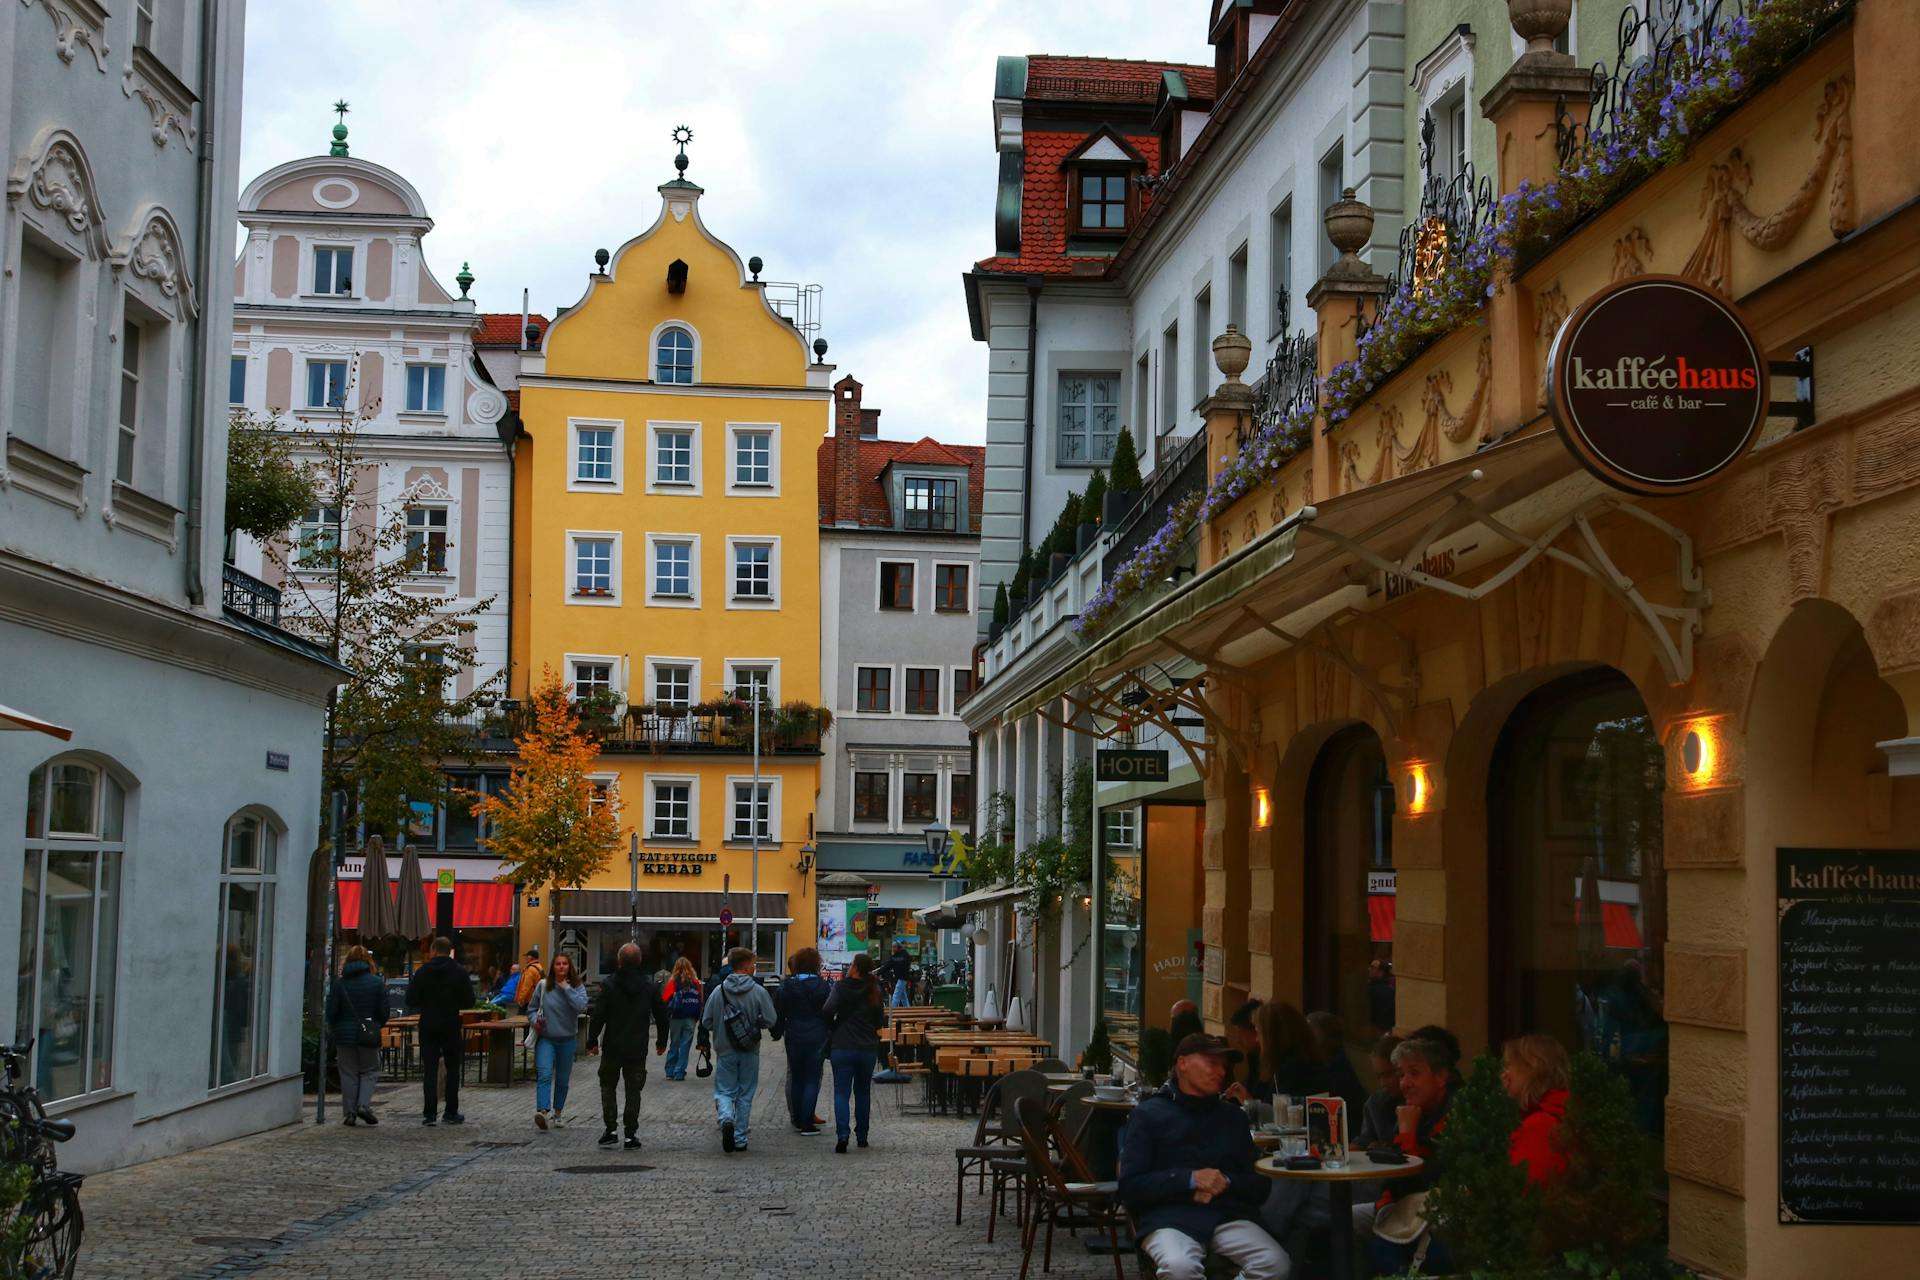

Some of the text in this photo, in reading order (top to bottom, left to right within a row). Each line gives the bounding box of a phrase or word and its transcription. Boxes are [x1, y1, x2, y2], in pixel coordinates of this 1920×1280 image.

[1572, 355, 1756, 389] kafféehaus
[1631, 395, 1702, 410] café & bar
[1101, 757, 1165, 775] HOTEL
[672, 853, 717, 862] VEGGIE
[643, 863, 702, 874] KEBAB
[1152, 956, 1185, 973] HADI
